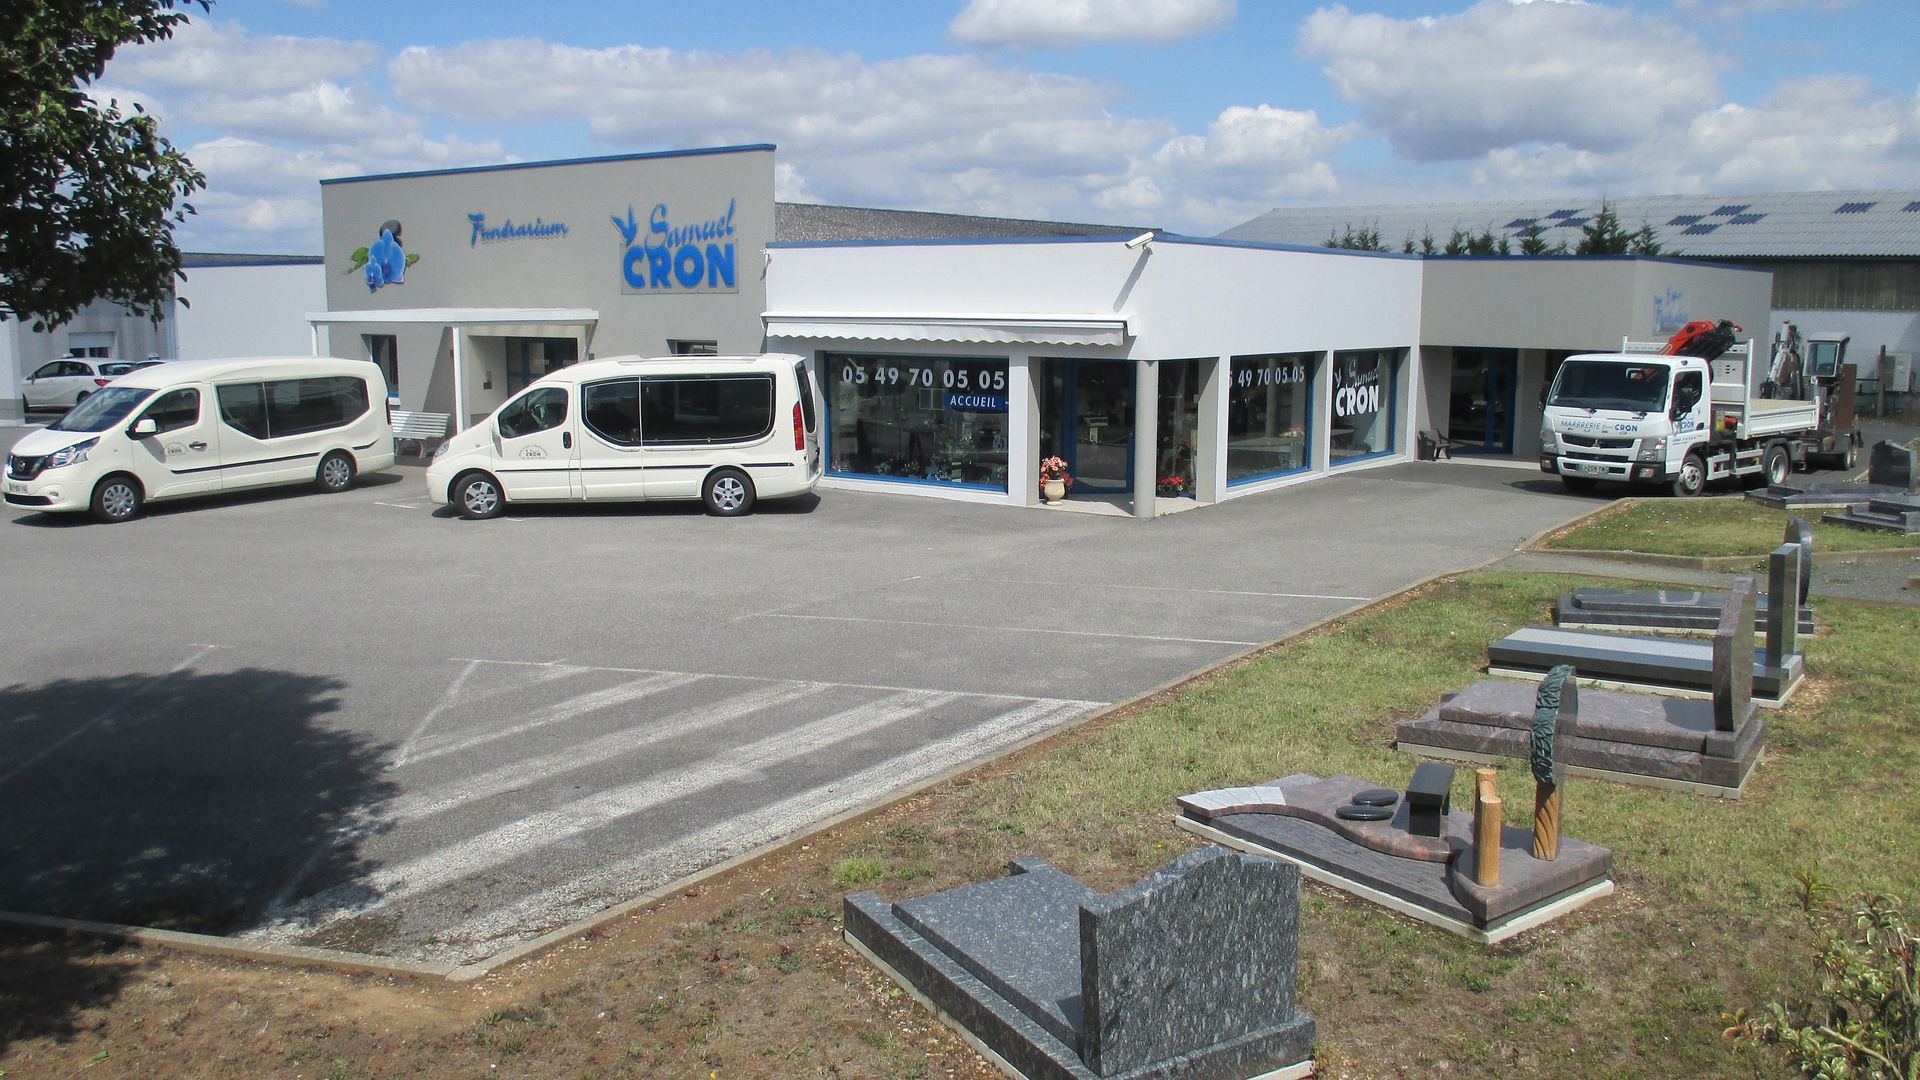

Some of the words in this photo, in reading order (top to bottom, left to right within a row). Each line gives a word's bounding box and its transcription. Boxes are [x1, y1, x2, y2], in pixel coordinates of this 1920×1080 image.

[645, 197, 735, 249] Samuel
[623, 243, 735, 289] CRON
[842, 365, 866, 384] 05
[874, 367, 899, 385] 49
[909, 368, 933, 387] 70
[943, 369, 969, 388] 05
[978, 371, 1005, 390] 05
[1238, 369, 1252, 388] 49
[1257, 367, 1271, 386] 70
[1275, 366, 1288, 385] 05
[1292, 365, 1305, 383] 05
[950, 395, 996, 408] ACCUEIL
[1335, 385, 1379, 417] CRON
[1561, 420, 1600, 430] MARBRERIE
[1614, 423, 1638, 432] CRON
